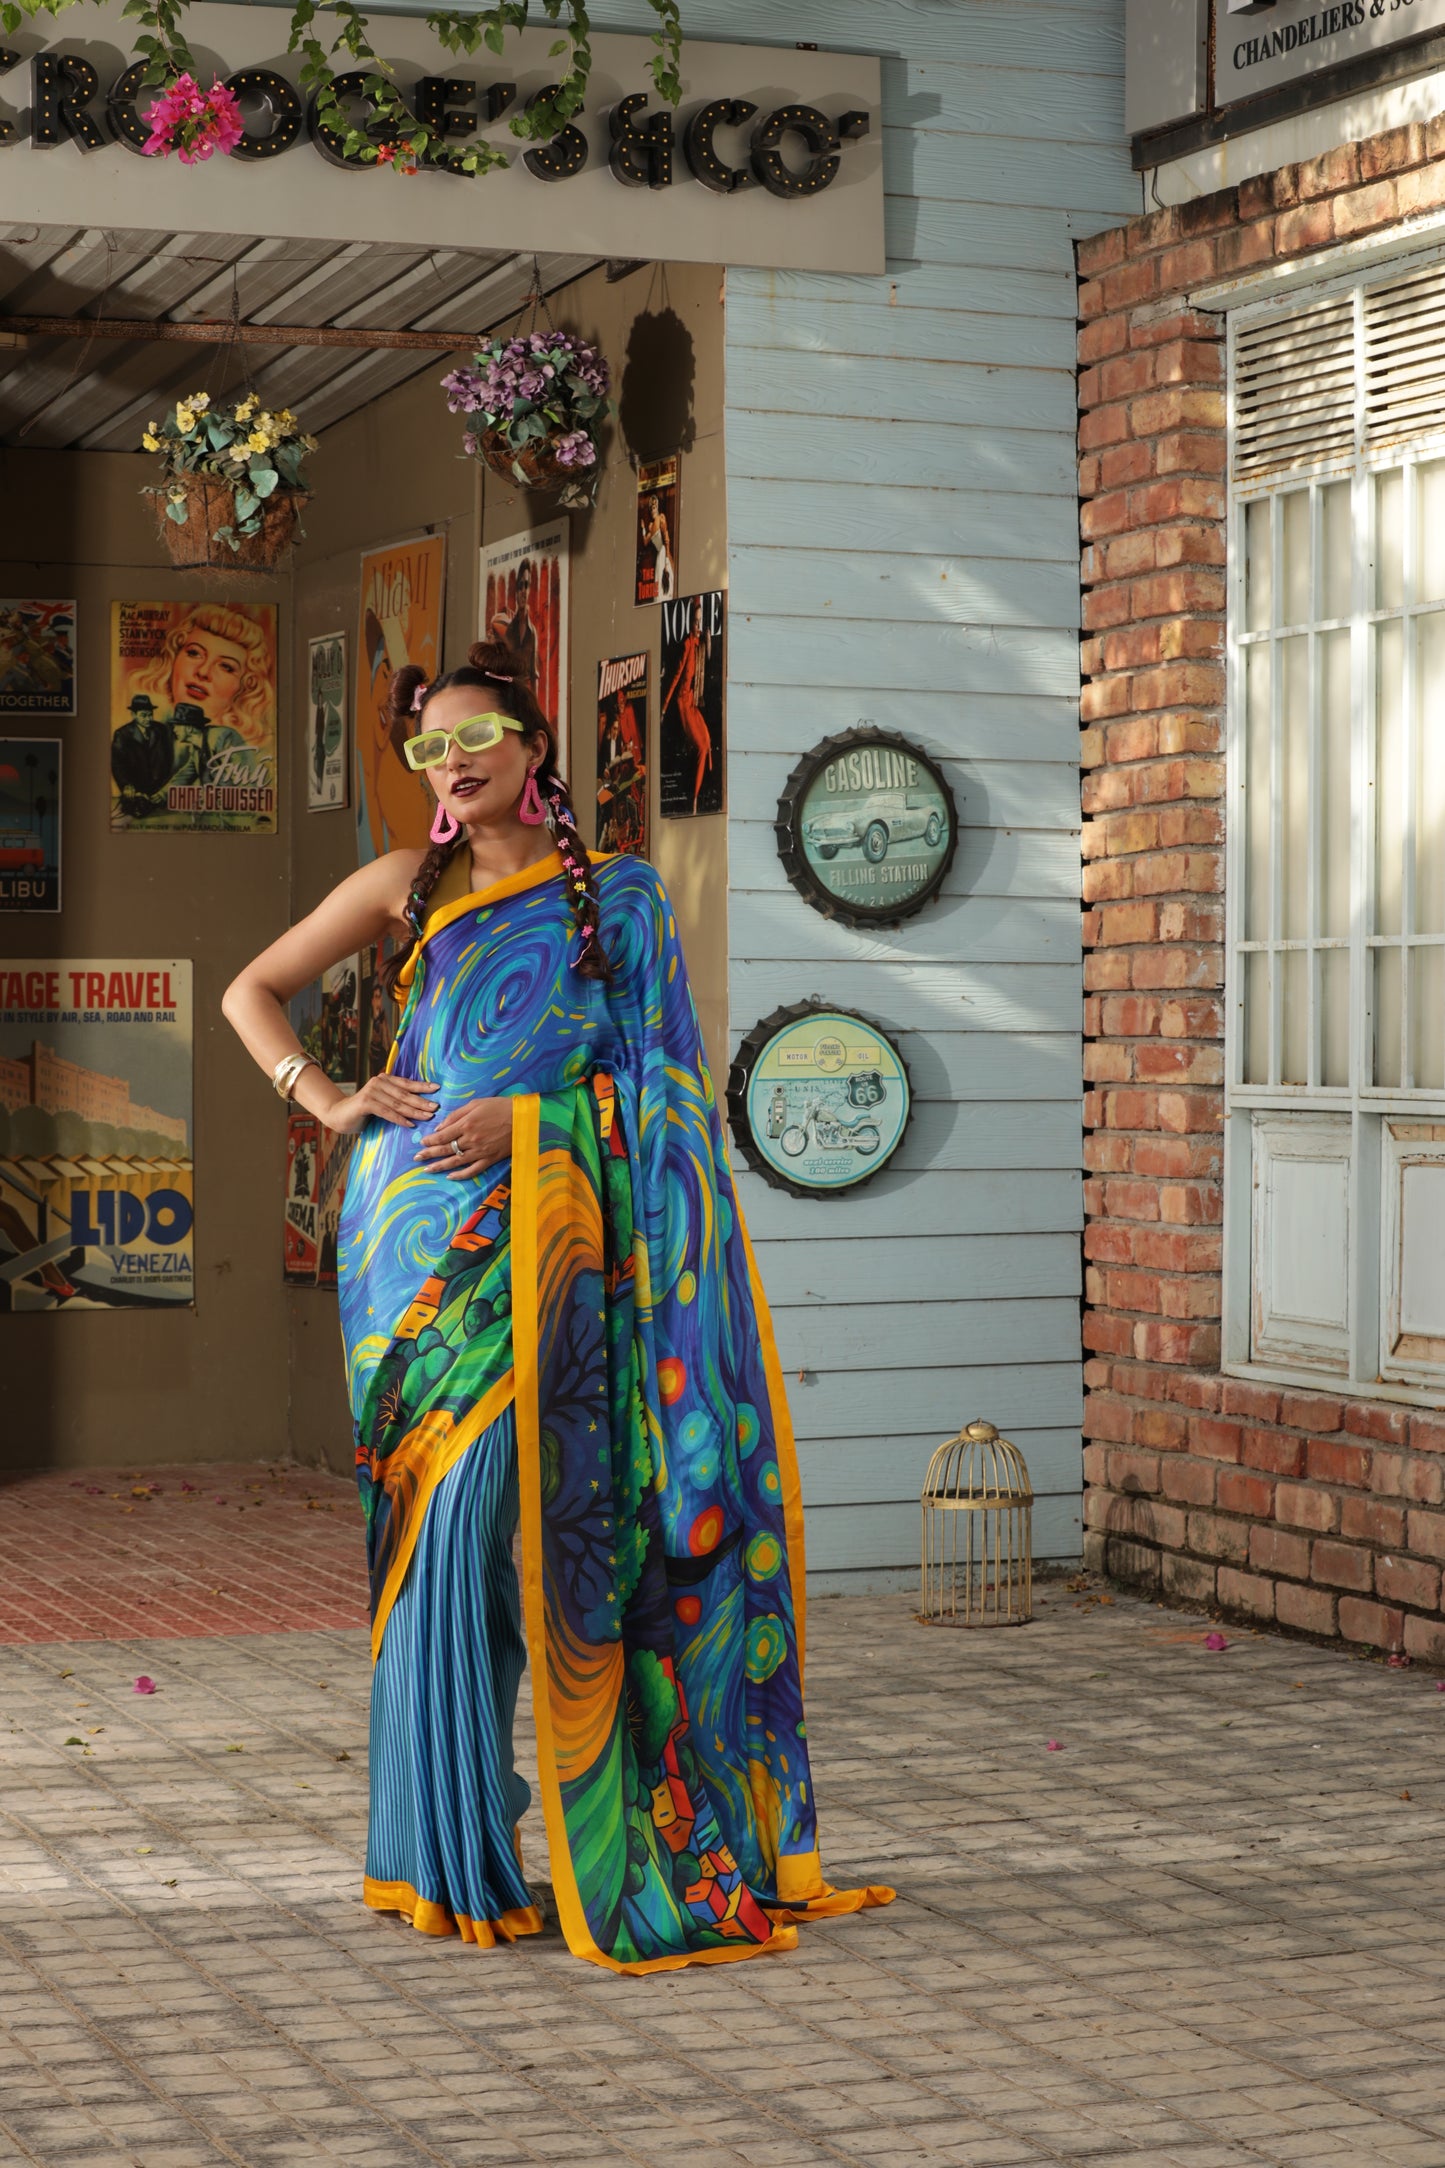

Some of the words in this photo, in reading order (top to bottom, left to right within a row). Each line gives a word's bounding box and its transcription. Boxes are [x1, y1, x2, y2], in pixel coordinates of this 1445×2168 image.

[1233, 0, 1365, 70] CHANDELIERS
[598, 653, 646, 701] THURSTON
[0, 695, 70, 707] TOGETHER
[824, 750, 919, 793] GASOLINE
[830, 866, 876, 887] FILLING
[881, 863, 928, 883] STATION
[68, 972, 177, 1008] TRAVEL
[17, 1012, 44, 1022] STYLE
[61, 1011, 81, 1024] AIR,
[83, 1011, 105, 1024] SEA,
[107, 1011, 131, 1022] ROAD
[133, 1011, 153, 1022] AND
[156, 1011, 177, 1022] RAIL
[855, 1085, 879, 1104] 66
[71, 1189, 193, 1245] LIDO
[111, 1253, 192, 1274] VENEZIA
